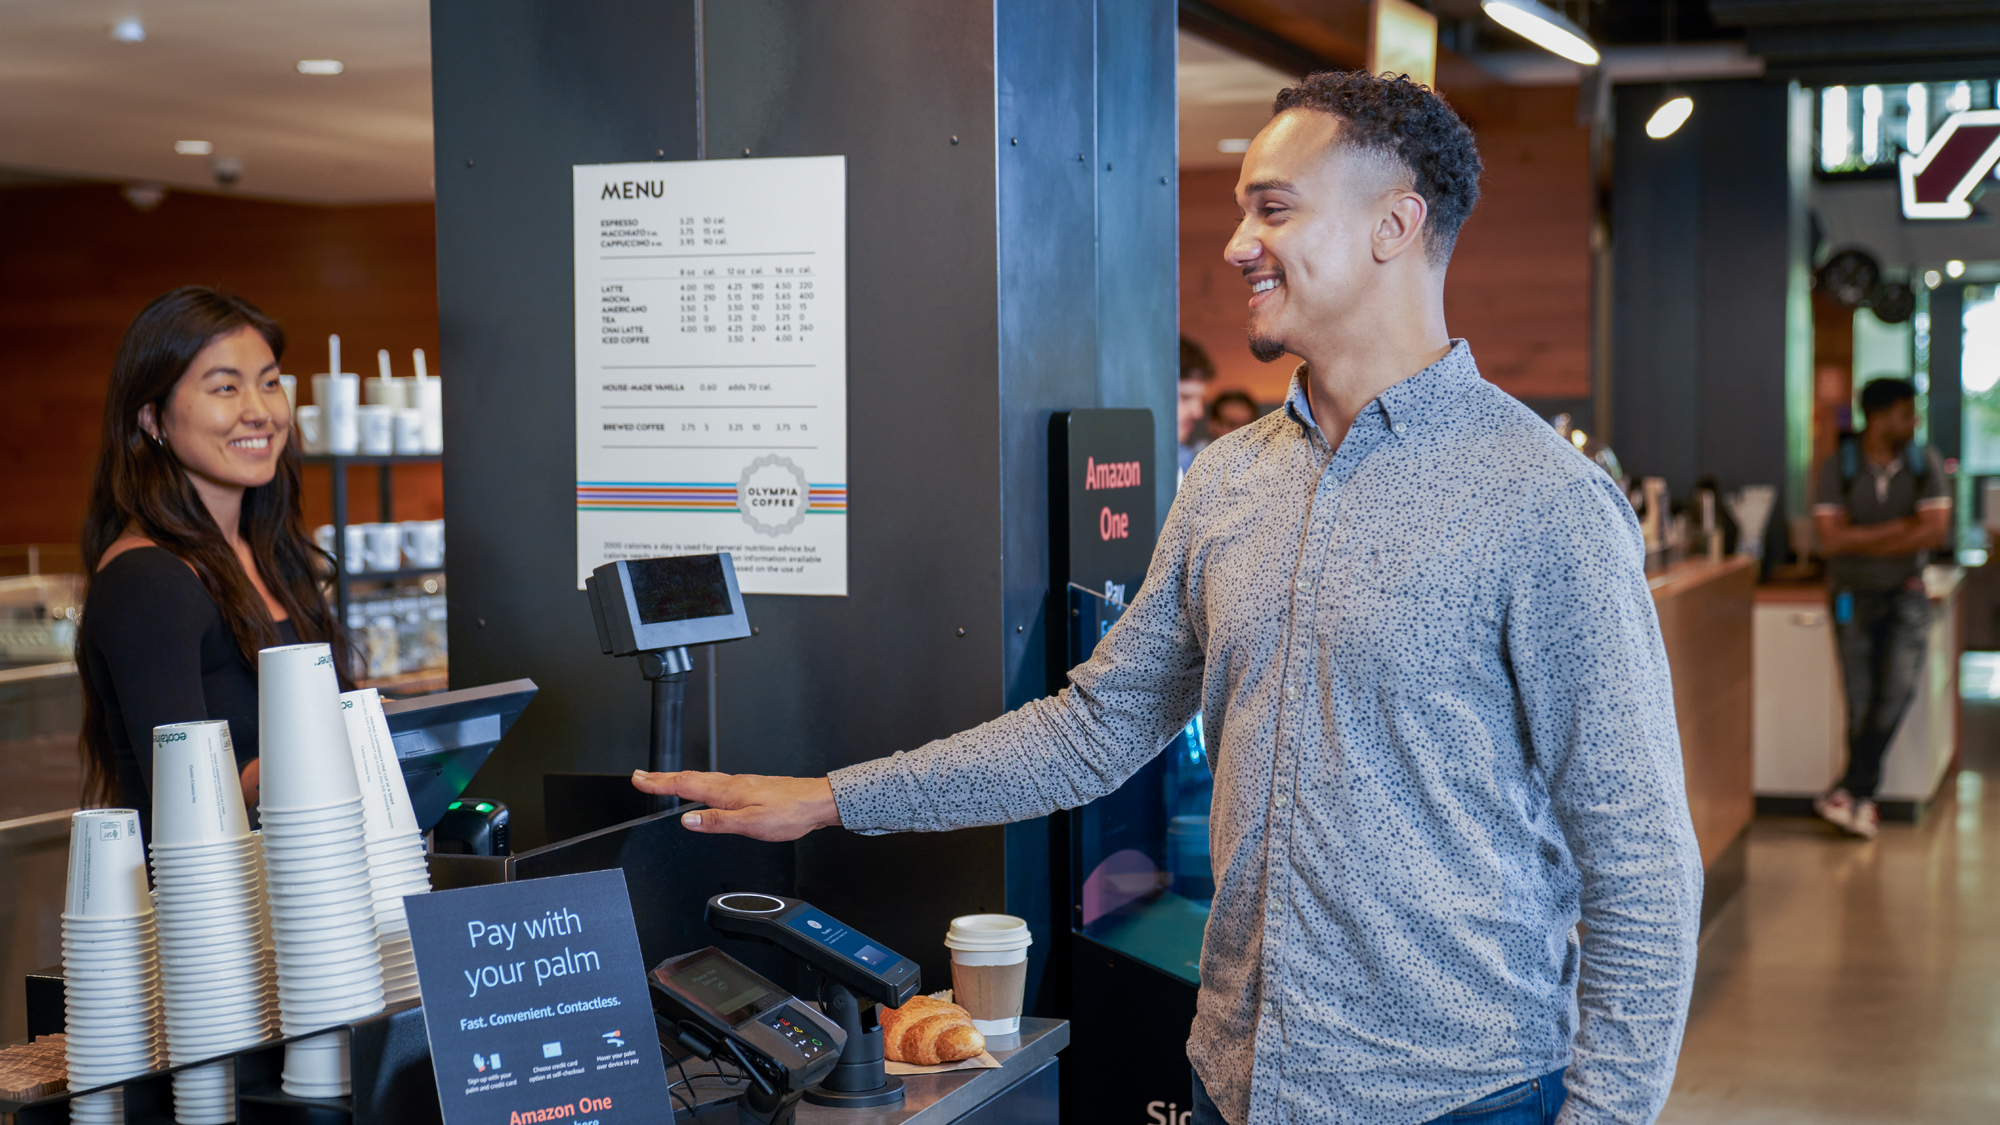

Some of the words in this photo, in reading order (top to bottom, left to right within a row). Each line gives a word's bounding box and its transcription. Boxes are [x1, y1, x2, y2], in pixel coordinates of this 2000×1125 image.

[601, 181, 663, 200] MENU
[601, 219, 638, 227] ESPRESSO
[680, 217, 694, 225] 3.25
[601, 229, 646, 237] MACCHIATO
[680, 238, 695, 246] 3.95
[601, 285, 623, 293] LATTE
[727, 283, 743, 291] 4.25
[704, 304, 708, 312] 5
[681, 315, 696, 323] 2.50
[728, 314, 742, 322] 3.25
[751, 314, 757, 322] 0
[799, 313, 805, 321] 0
[728, 335, 744, 343] 3.50
[748, 383, 757, 391] 70
[681, 423, 696, 431] 2.75
[1085, 456, 1141, 491] Amazon
[748, 488, 797, 496] OLYMPIA
[752, 499, 793, 507] COFFEE
[1100, 506, 1129, 541] One
[660, 543, 673, 551] day
[702, 543, 713, 551] for
[715, 545, 742, 553] general
[1104, 580, 1125, 611] Pay
[468, 920, 517, 951] Pay
[523, 907, 582, 940] with
[464, 960, 526, 998] your
[534, 947, 601, 986] palm
[459, 1018, 487, 1031] Fast.
[489, 1007, 556, 1026] Convenient.
[557, 996, 621, 1015] Contactless.
[611, 1052, 623, 1060] your
[623, 1050, 636, 1058] palm
[533, 1064, 551, 1074] Choose
[551, 1062, 566, 1071] credit
[566, 1059, 578, 1068] card
[596, 1063, 608, 1071] over
[608, 1060, 624, 1069] device
[630, 1058, 640, 1066] pay
[467, 1077, 479, 1086] Sign
[487, 1073, 500, 1082] with
[500, 1072, 512, 1080] your
[528, 1073, 545, 1083] option
[552, 1067, 585, 1079] self-checkout
[479, 1083, 490, 1091] and
[490, 1080, 504, 1089] credit
[505, 1079, 517, 1087] card
[510, 1103, 575, 1125] Amazon
[579, 1096, 612, 1114] One
